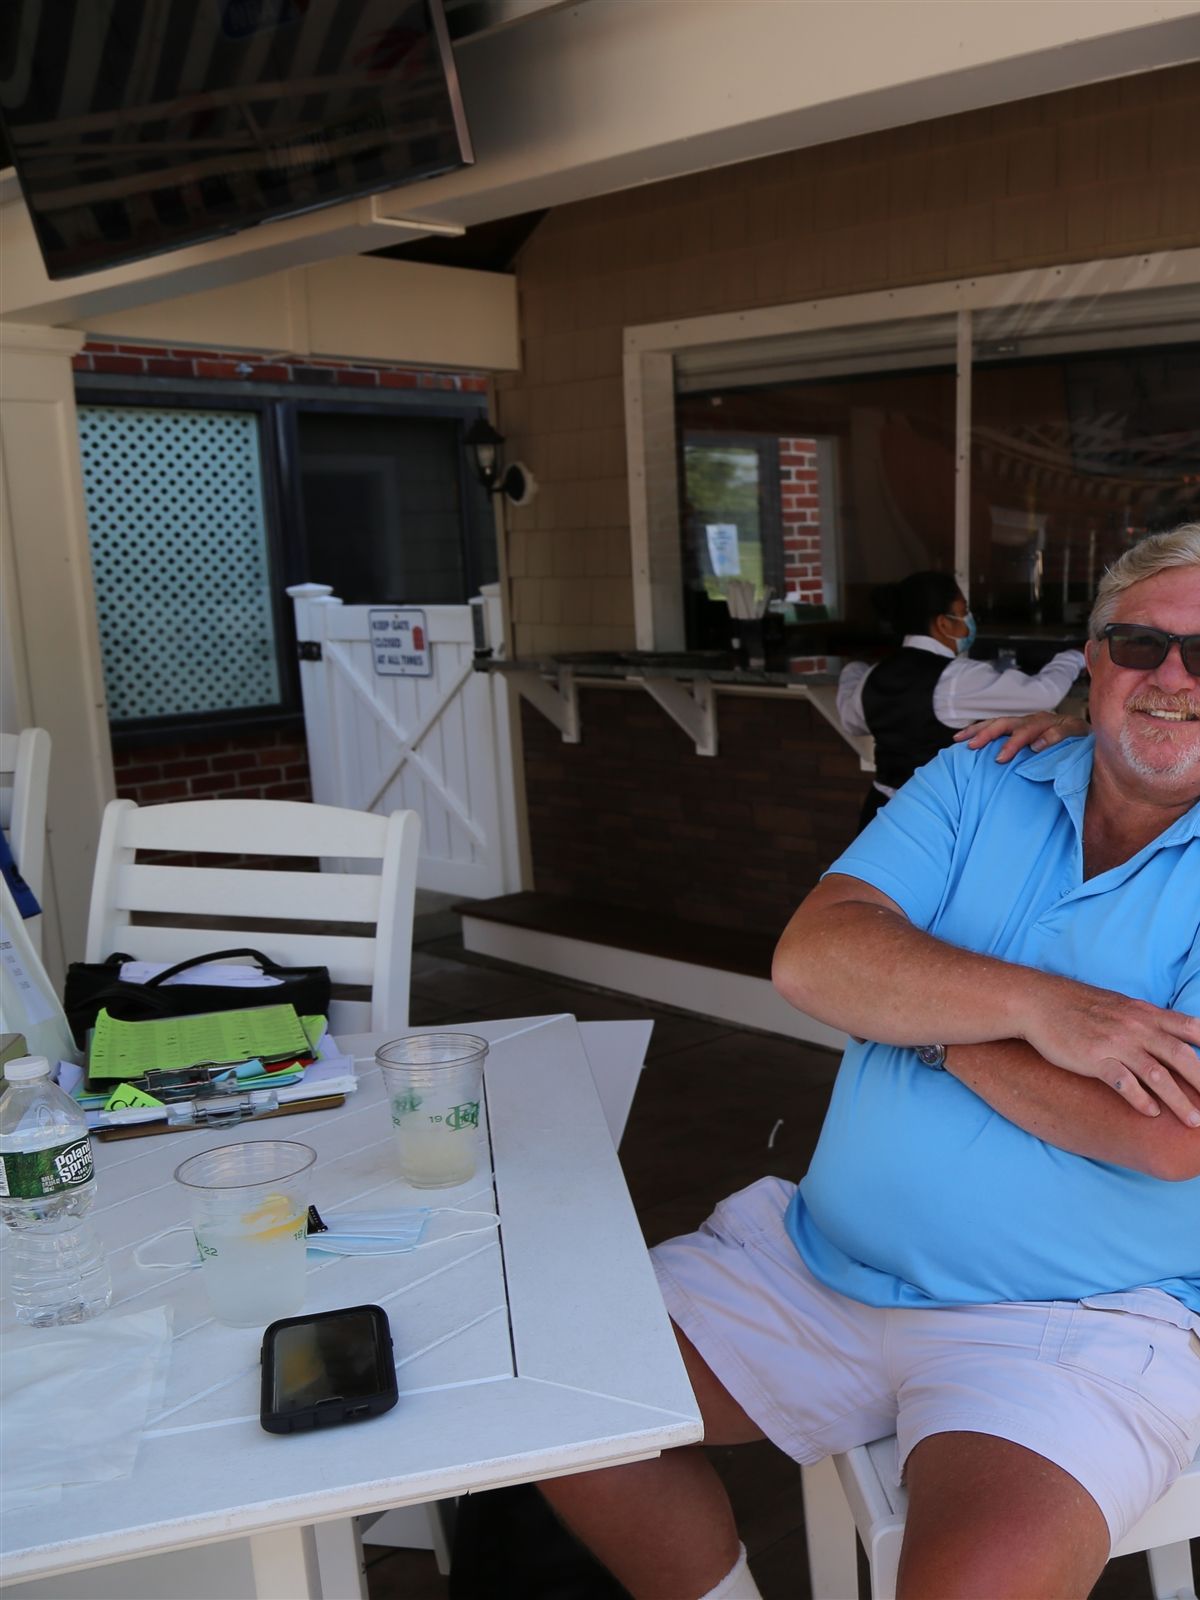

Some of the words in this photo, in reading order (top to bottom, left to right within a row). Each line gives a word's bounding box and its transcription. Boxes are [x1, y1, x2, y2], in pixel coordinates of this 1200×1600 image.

[373, 620, 389, 631] KEEP
[392, 620, 410, 631] GATE
[374, 637, 402, 648] CLOSED
[378, 654, 387, 665] AT
[387, 655, 400, 666] ALL
[401, 655, 424, 667] TIMES
[428, 1114, 443, 1124] 19
[54, 1138, 92, 1171] Poland
[59, 1151, 94, 1183] Spring
[203, 1246, 219, 1257] 22
